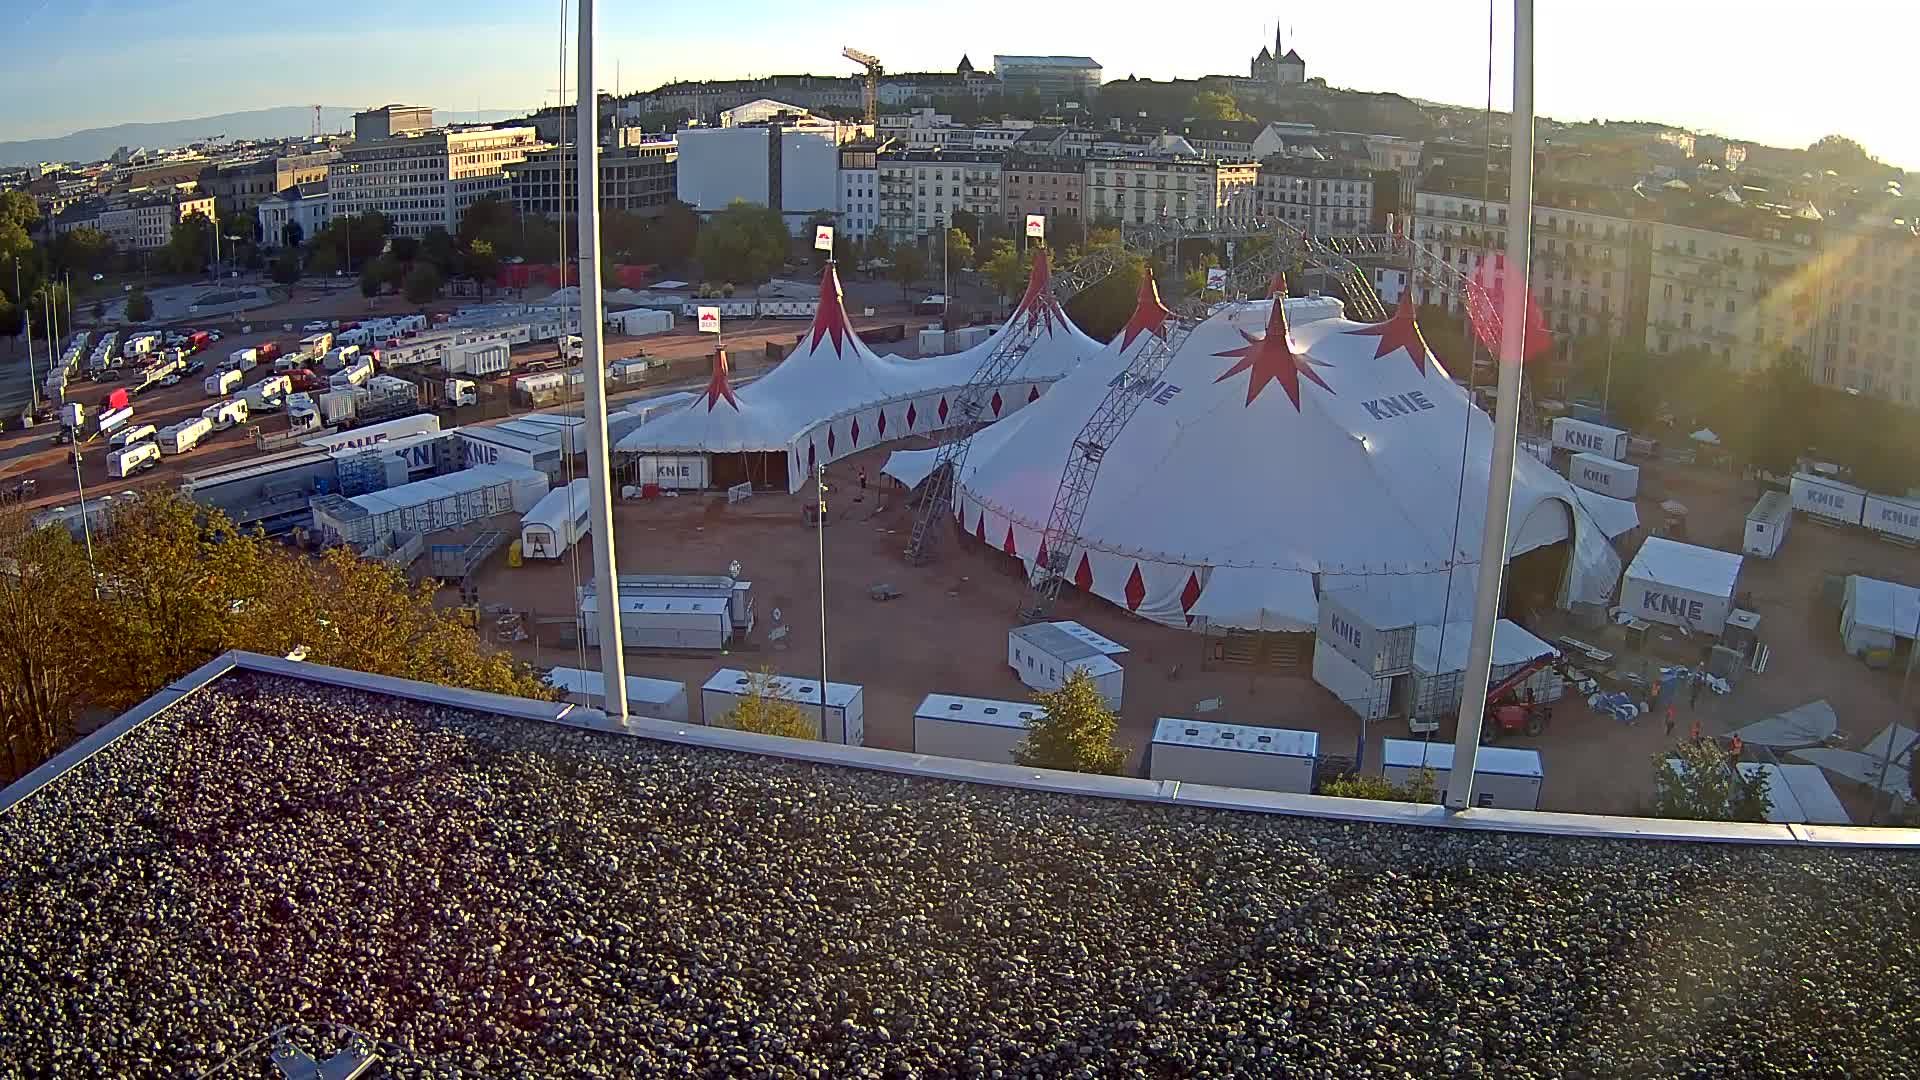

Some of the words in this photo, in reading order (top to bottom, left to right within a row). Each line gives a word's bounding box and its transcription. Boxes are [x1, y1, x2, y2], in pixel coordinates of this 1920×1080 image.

[1361, 391, 1435, 420] KNIE
[1565, 428, 1604, 450] KNIE
[463, 440, 498, 465] KNIE
[656, 465, 690, 478] KNIE
[1583, 466, 1610, 485] KNIE
[1808, 489, 1845, 509] KNIE
[1643, 590, 1704, 620] KNIE
[1331, 612, 1361, 648] KNIE
[1015, 648, 1056, 682] KNIE
